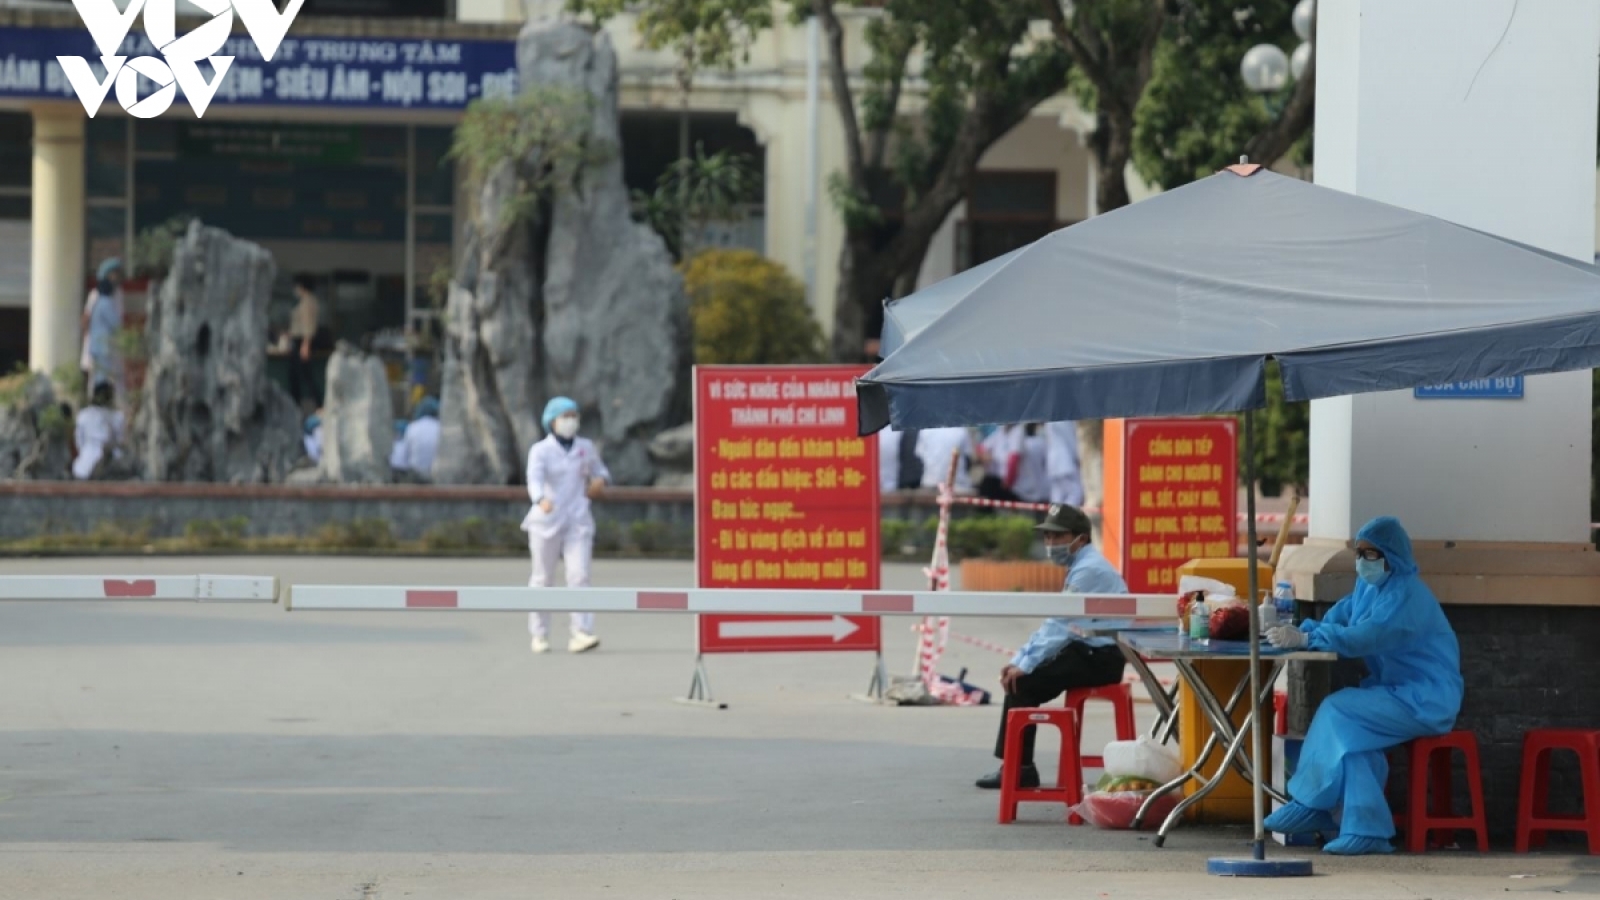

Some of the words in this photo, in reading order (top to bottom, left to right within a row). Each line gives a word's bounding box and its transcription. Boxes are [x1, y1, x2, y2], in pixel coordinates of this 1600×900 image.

[303, 40, 397, 63] TRUNG
[402, 39, 461, 64] TÂM
[275, 64, 328, 99] SIÊU
[332, 63, 370, 100] ÂM
[427, 72, 468, 103] SOI
[709, 379, 721, 399] VÌ
[771, 402, 795, 425] PHỐ
[819, 406, 846, 425] LINH
